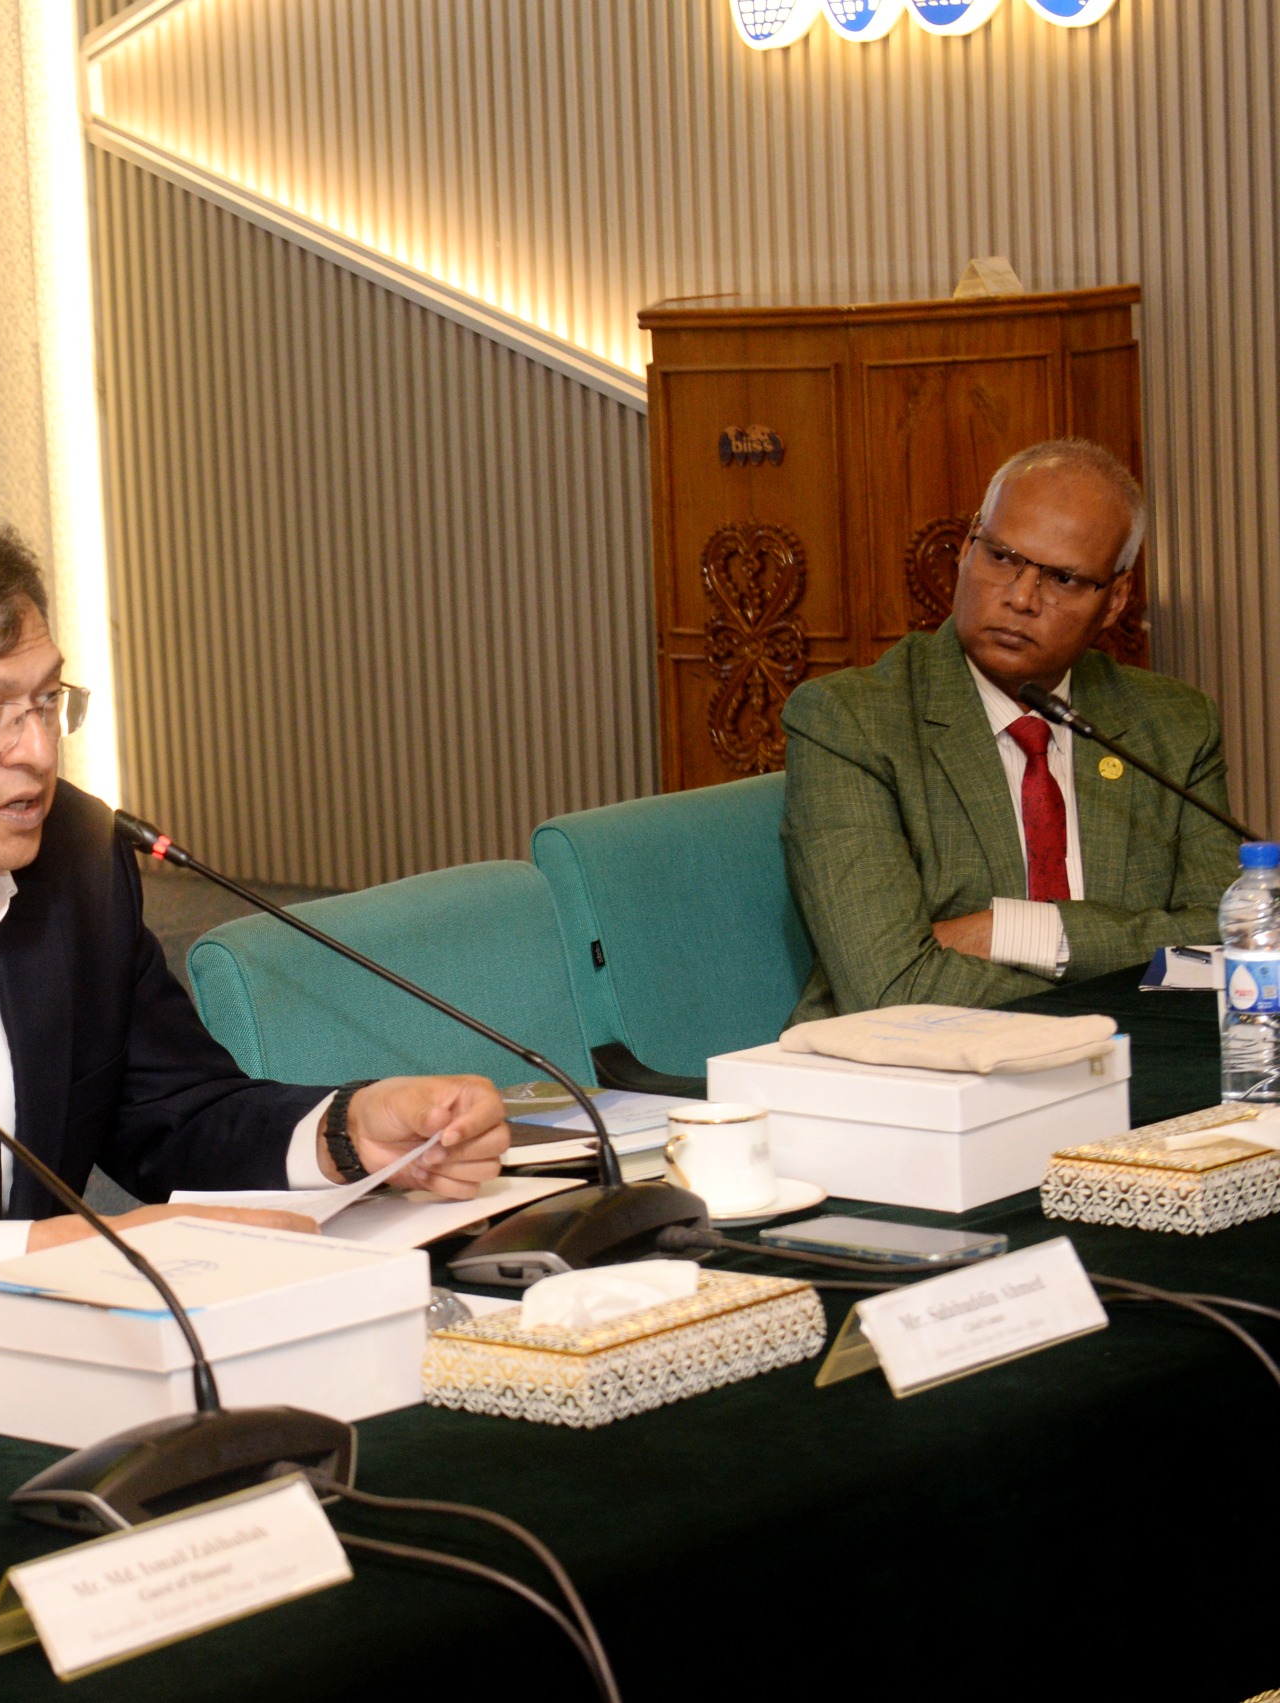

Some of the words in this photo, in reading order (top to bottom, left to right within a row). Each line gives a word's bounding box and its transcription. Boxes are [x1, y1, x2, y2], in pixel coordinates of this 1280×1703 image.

[71, 1576, 104, 1599] Mr.
[104, 1563, 137, 1588] Md.
[138, 1548, 190, 1576] Ismail
